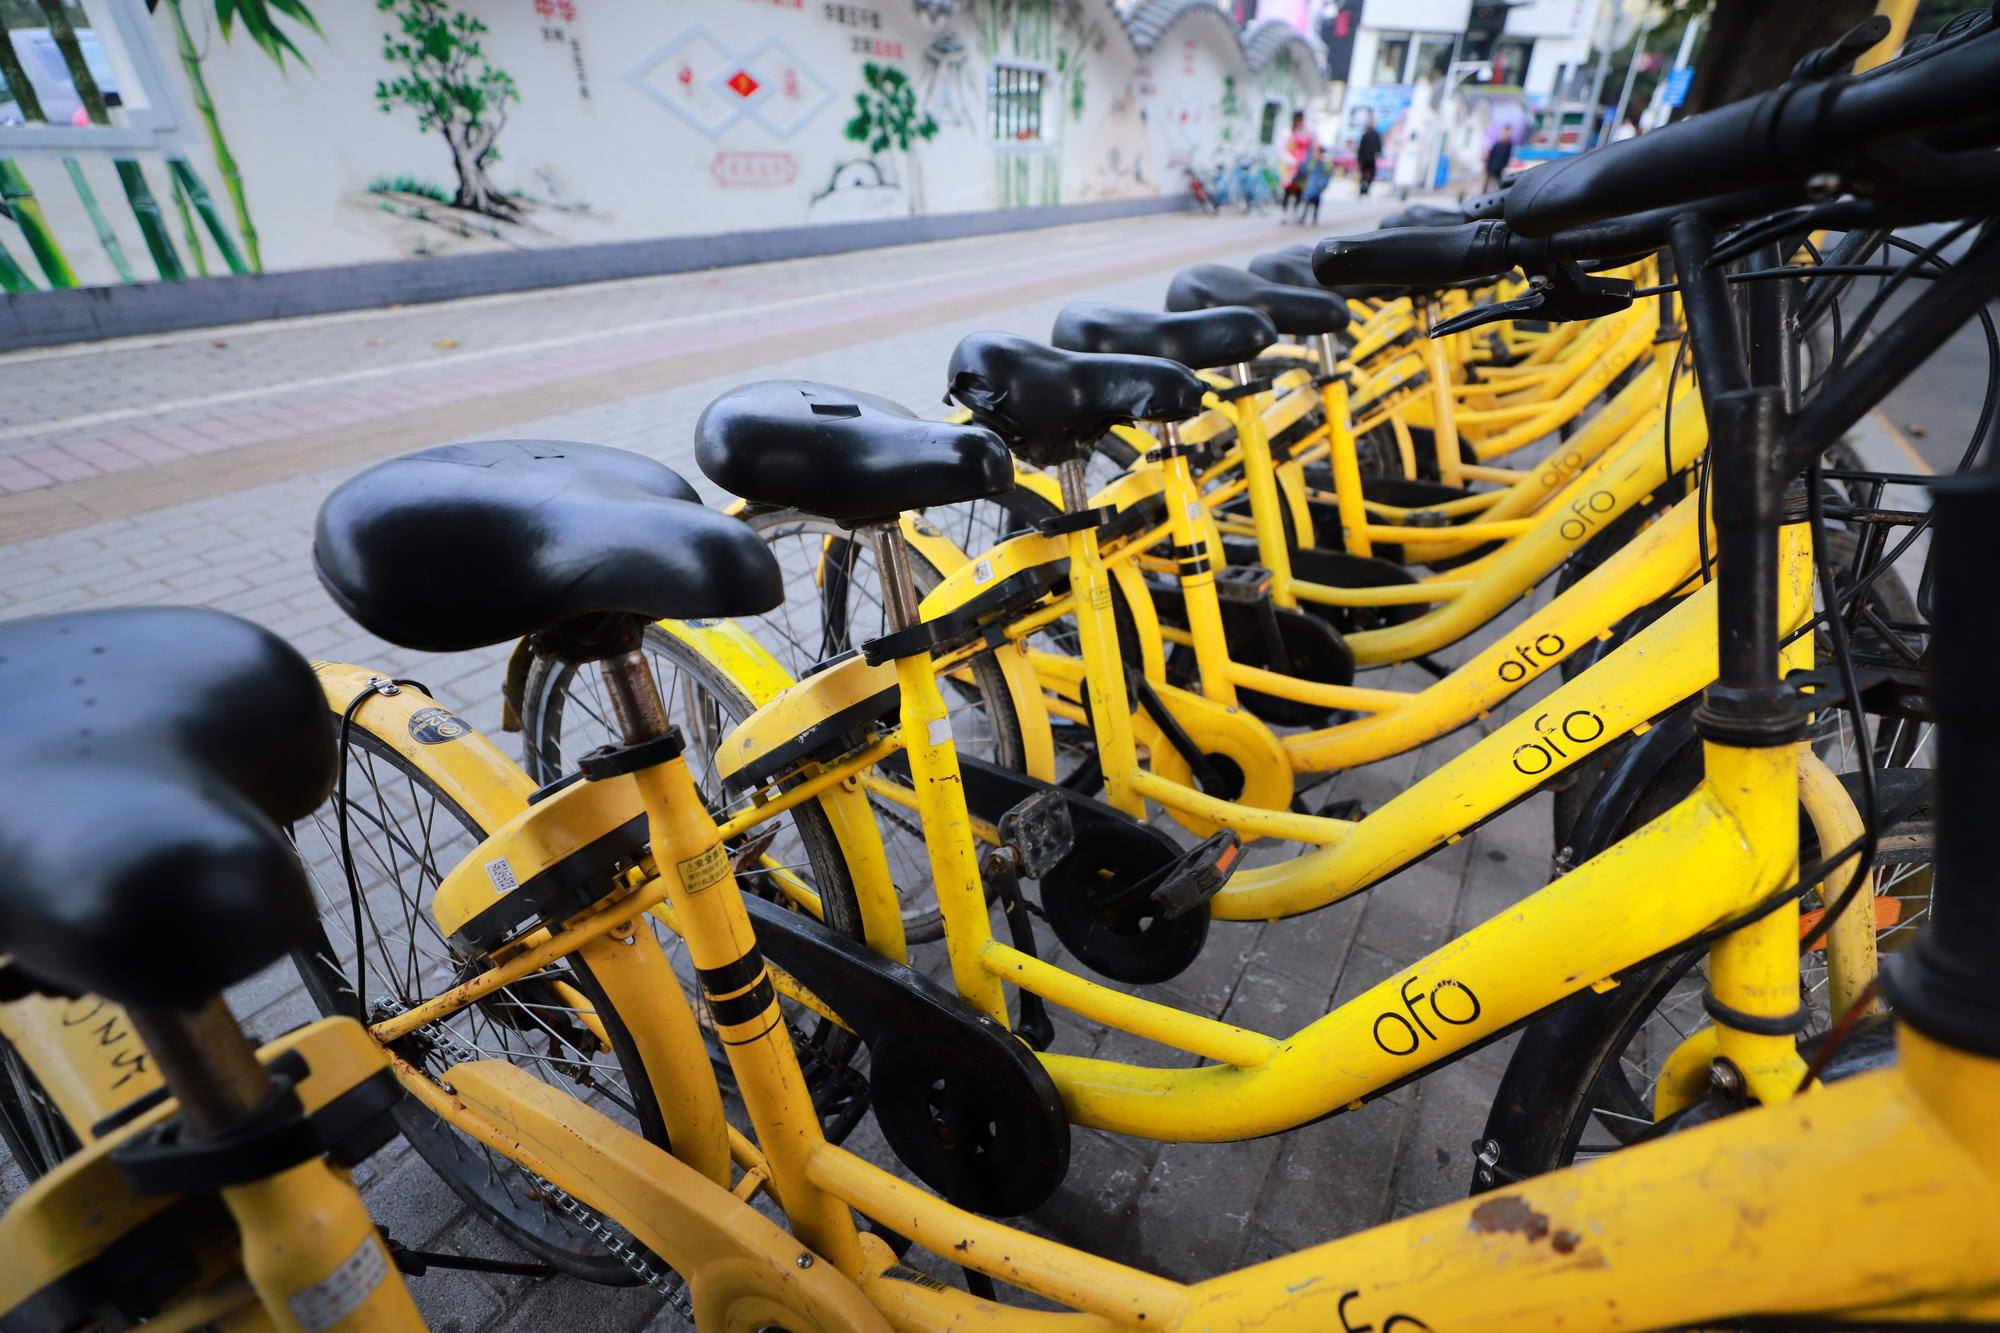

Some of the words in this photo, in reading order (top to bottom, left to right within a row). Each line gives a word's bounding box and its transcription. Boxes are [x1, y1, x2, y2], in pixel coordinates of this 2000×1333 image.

[1541, 451, 1583, 488] ofo
[1560, 490, 1616, 541] ofo
[1498, 633, 1565, 683] ofo
[1512, 710, 1605, 775] ofo
[1373, 975, 1481, 1056] ofo
